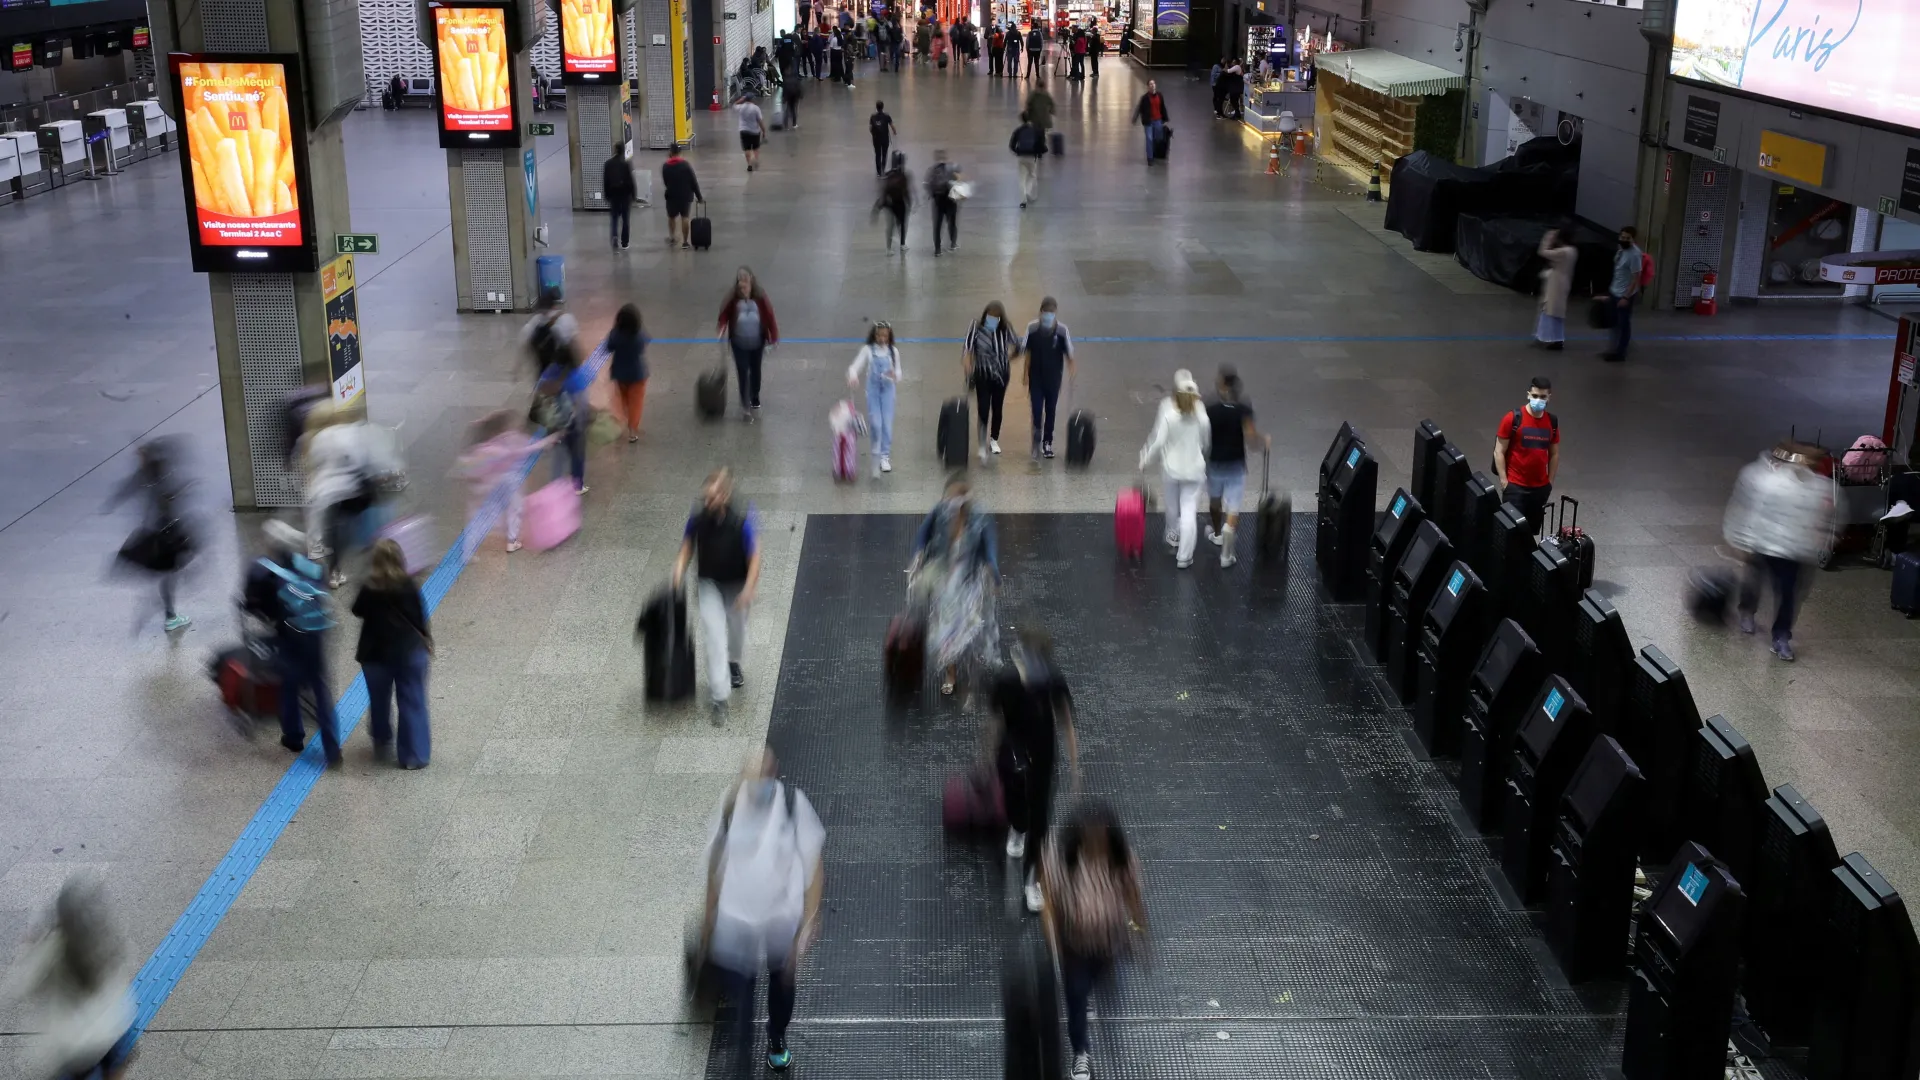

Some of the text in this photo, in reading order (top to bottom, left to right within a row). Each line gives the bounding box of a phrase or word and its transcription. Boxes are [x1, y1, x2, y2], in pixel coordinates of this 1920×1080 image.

[184, 76, 275, 89] #FomeDeMéqui
[203, 90, 266, 103] Sentiu, né?
[203, 221, 226, 229] Visite
[251, 221, 296, 229] restaurante
[219, 230, 253, 238] Terminal
[347, 259, 353, 281] D
